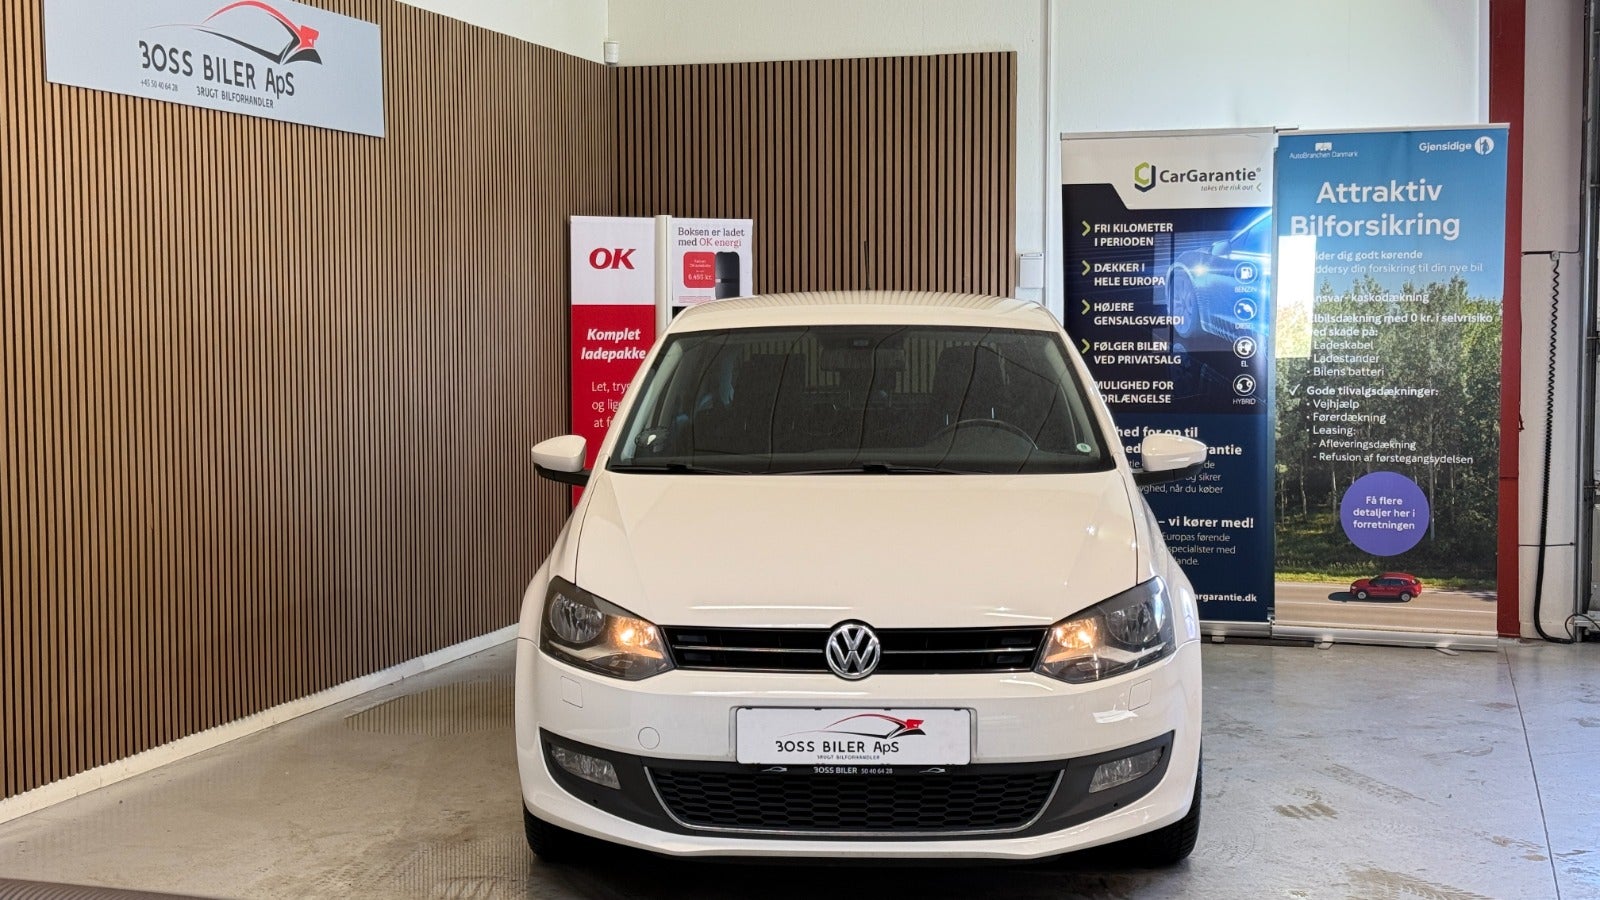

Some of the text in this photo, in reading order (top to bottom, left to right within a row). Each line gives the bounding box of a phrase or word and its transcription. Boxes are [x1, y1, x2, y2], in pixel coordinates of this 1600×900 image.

[138, 40, 295, 99] BOSS BILER ApS
[196, 85, 274, 109] BRUGT BILFORHANDLER
[1419, 142, 1472, 153] Gjensidige
[1159, 168, 1256, 183] CarGarantie
[1316, 178, 1443, 204] Attraktiv
[677, 226, 745, 237] Boksen er ladet
[1094, 223, 1173, 233] FRI KILOMETER
[1290, 212, 1460, 241] Bilforsikring
[677, 238, 742, 249] med OK energi
[1094, 237, 1154, 247] I PERIODEN
[589, 247, 637, 270] OK
[1337, 250, 1353, 262] dig
[1355, 250, 1379, 262] godt
[1381, 249, 1423, 260] kørende
[1094, 263, 1145, 273] DÆKKER I
[1315, 263, 1483, 275] ddersy din forsikring til din nye bil
[1094, 276, 1166, 286] HELE EUROPA
[1351, 292, 1430, 304] kaskodækning
[1093, 302, 1135, 312] HØJERE
[1093, 315, 1185, 325] GENSALGSVÆRDI
[1312, 313, 1382, 325] lbilsdækning
[1384, 313, 1408, 323] med
[1410, 313, 1418, 323] 0
[1420, 313, 1434, 323] kr.
[1442, 313, 1493, 323] selvrisiko
[587, 328, 641, 344] Komplet
[1313, 326, 1378, 339] ed skade på:
[1093, 341, 1167, 352] FØLGER BILEN
[1314, 340, 1375, 350] Ladeskabel
[580, 347, 646, 363] ladepakke
[1093, 355, 1182, 365] VED PRIVATSALG
[1314, 353, 1380, 364] Ladestander
[1313, 367, 1385, 377] Bilens batteri
[592, 381, 610, 394] Let,
[1095, 380, 1174, 390] MULIGHED FOR
[1306, 386, 1439, 398] Gode tilvalgsdækninger:
[1100, 394, 1172, 404] ORLÆNGELSE
[591, 401, 605, 413] og
[1313, 399, 1360, 411] Vejhjælp
[593, 417, 604, 428] at
[1313, 412, 1387, 424] Førerdækning
[1184, 426, 1198, 438] til
[1313, 425, 1356, 437] Leasing:
[1206, 443, 1242, 455] rantie
[1319, 439, 1417, 450] Afleveringsdækning
[1319, 453, 1474, 466] Refusion af førstegangsydelsen
[1198, 472, 1222, 481] sikrer
[1169, 483, 1183, 493] når
[1185, 485, 1197, 493] du
[1198, 484, 1224, 494] køber
[1365, 495, 1403, 505] Få flere
[1353, 508, 1391, 519] detaljer
[1393, 508, 1410, 518] her
[1168, 516, 1180, 527] vi
[1183, 516, 1218, 528] kører
[1221, 517, 1254, 529] med!
[1352, 519, 1415, 531] forretningen
[1196, 532, 1231, 542] førende
[1216, 545, 1236, 554] med
[775, 740, 899, 755] BOSS BILER ApS
[813, 766, 893, 775] BOSS BILER 50 40 64 28
